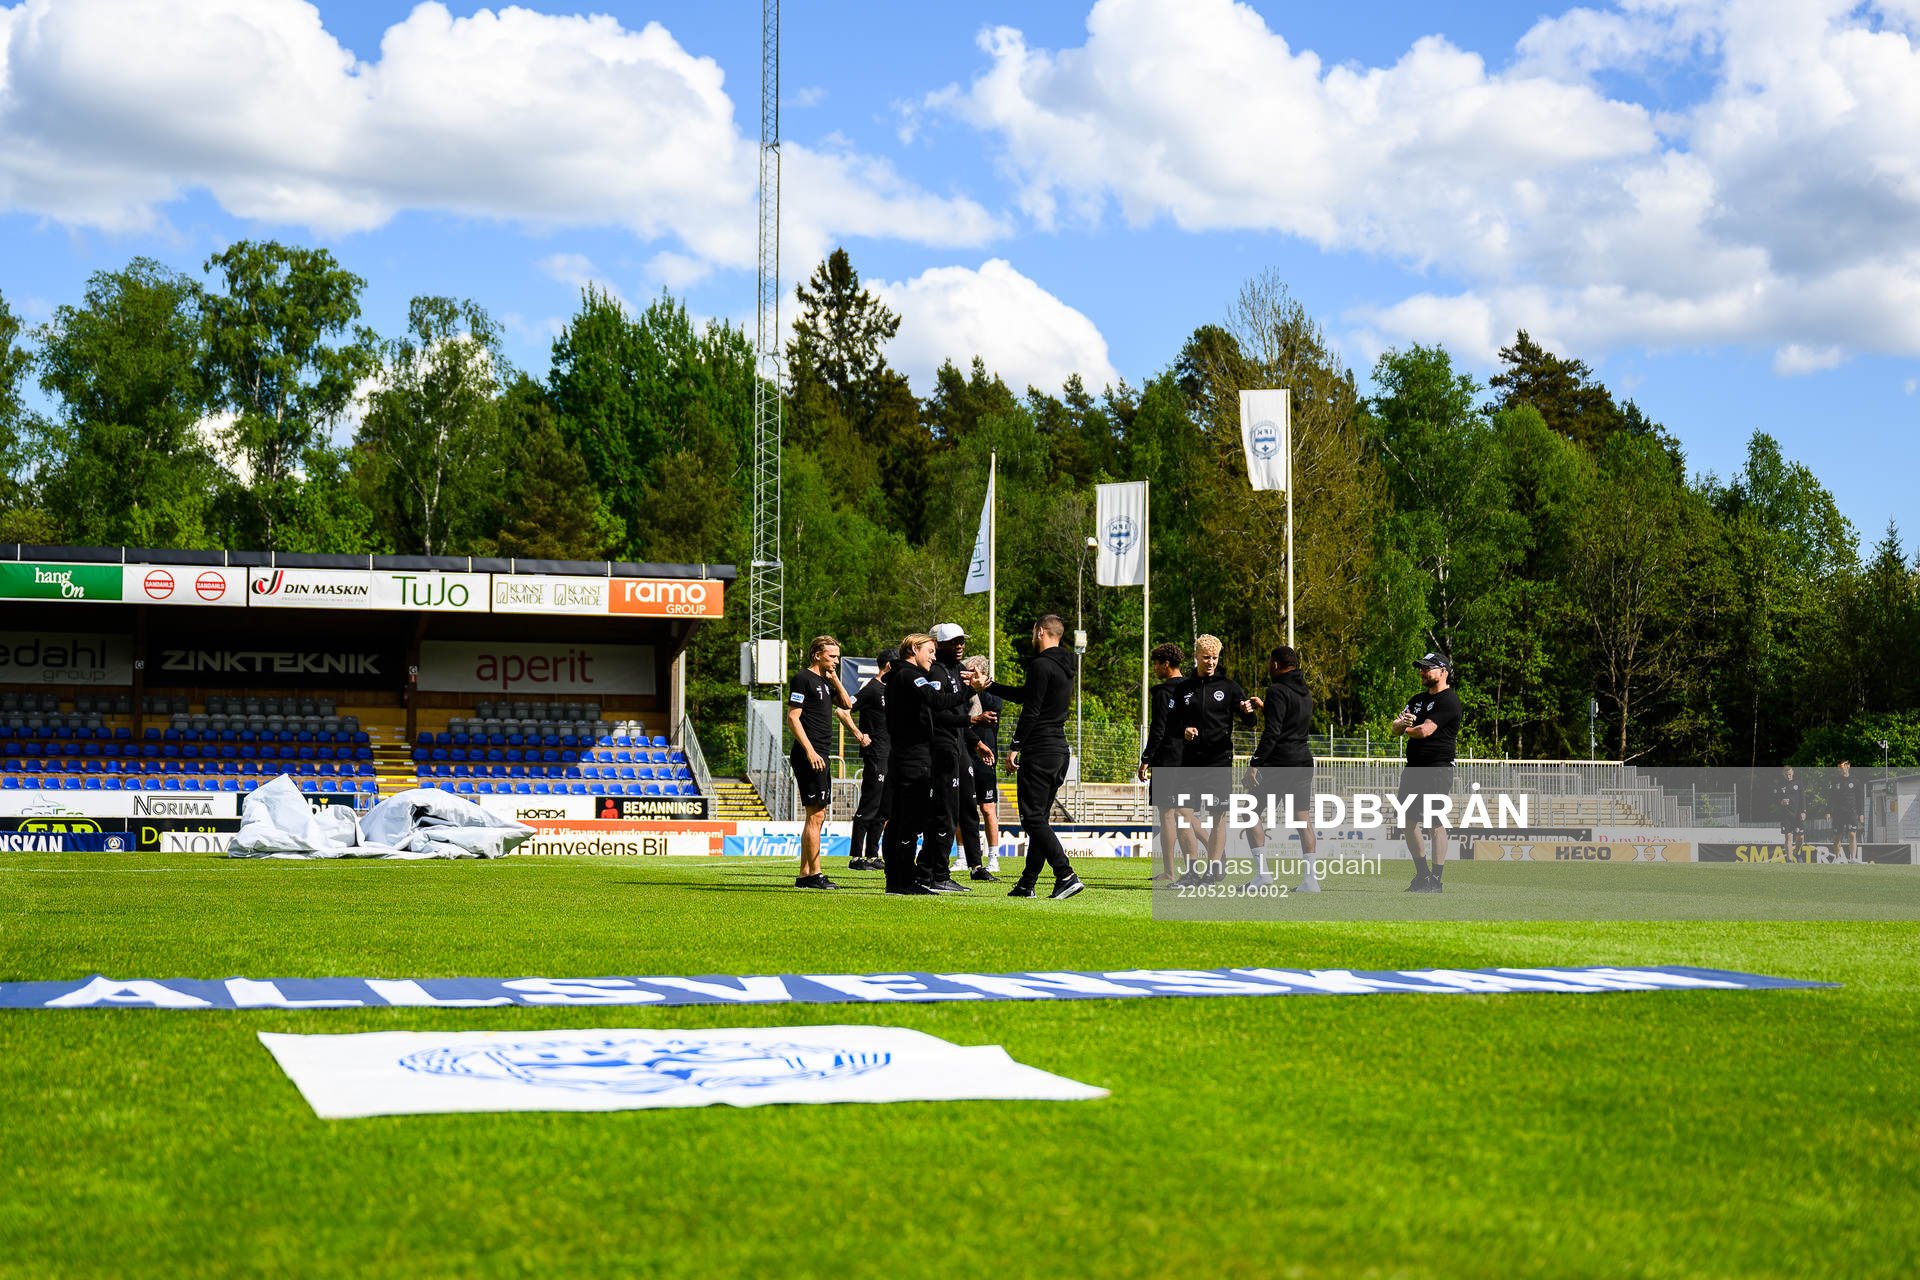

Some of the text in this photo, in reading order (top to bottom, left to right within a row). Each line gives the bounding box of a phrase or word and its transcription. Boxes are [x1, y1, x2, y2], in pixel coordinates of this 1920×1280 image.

[35, 567, 73, 585] hang
[61, 581, 84, 599] On
[284, 584, 369, 595] DIN MASKIN
[510, 583, 544, 594] KONST
[568, 585, 601, 596] KONST
[625, 581, 706, 604] ramo
[510, 594, 544, 604] SMIDE
[568, 596, 602, 606] SMIDE
[666, 603, 707, 615] GROUP
[161, 649, 381, 675] ZINKTEKNIK
[475, 649, 594, 689] aperit
[42, 670, 105, 683] group
[134, 795, 214, 816] NORIMA
[623, 801, 702, 815] BEMANNINGS
[516, 808, 566, 819] HORDA
[643, 838, 668, 856] Bil
[1555, 845, 1612, 861] HECO
[44, 967, 1748, 1009] ALLSVENSKAN
